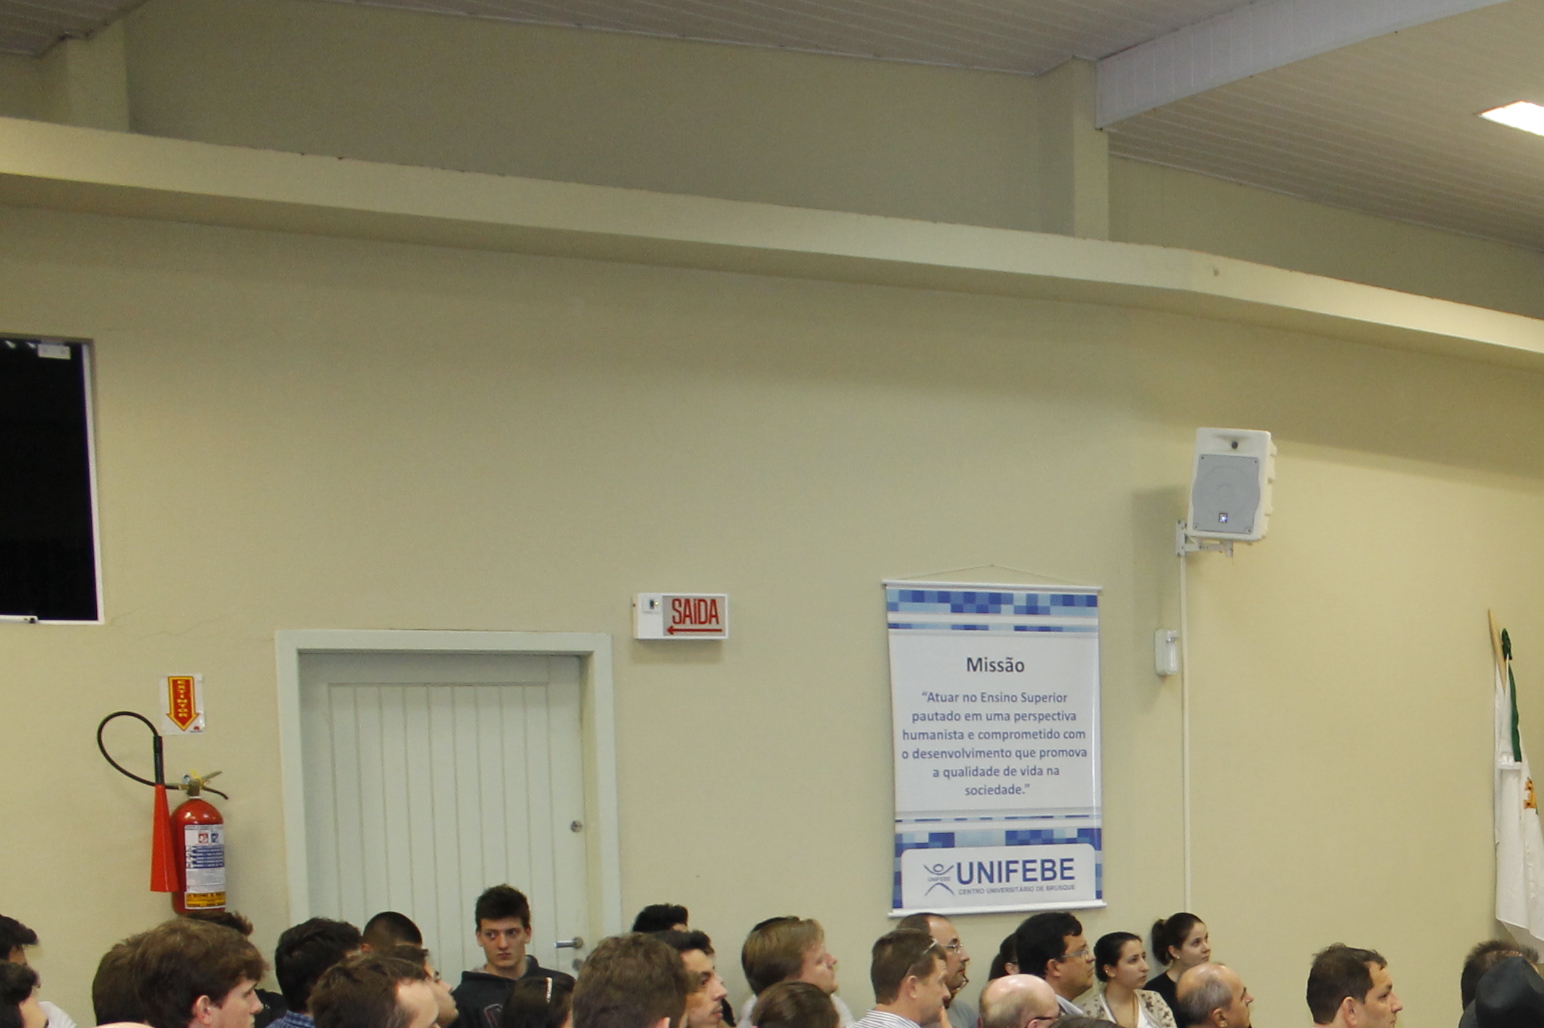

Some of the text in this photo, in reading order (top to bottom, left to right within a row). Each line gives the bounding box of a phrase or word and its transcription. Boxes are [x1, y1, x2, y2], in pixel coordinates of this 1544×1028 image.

[672, 598, 720, 624] SAÍDA
[966, 657, 1025, 673] Missão
[963, 694, 977, 703] no
[981, 692, 1018, 703] Ensino
[1021, 692, 1067, 704] Superior
[912, 710, 1076, 723] pautado em uma perspectiva
[902, 729, 1086, 741] humanista e comprometido com
[902, 748, 1087, 760] o desenvolvimento que promova
[933, 766, 1059, 779] a qualidade de vida na
[957, 858, 1075, 885] UNIFEBE
